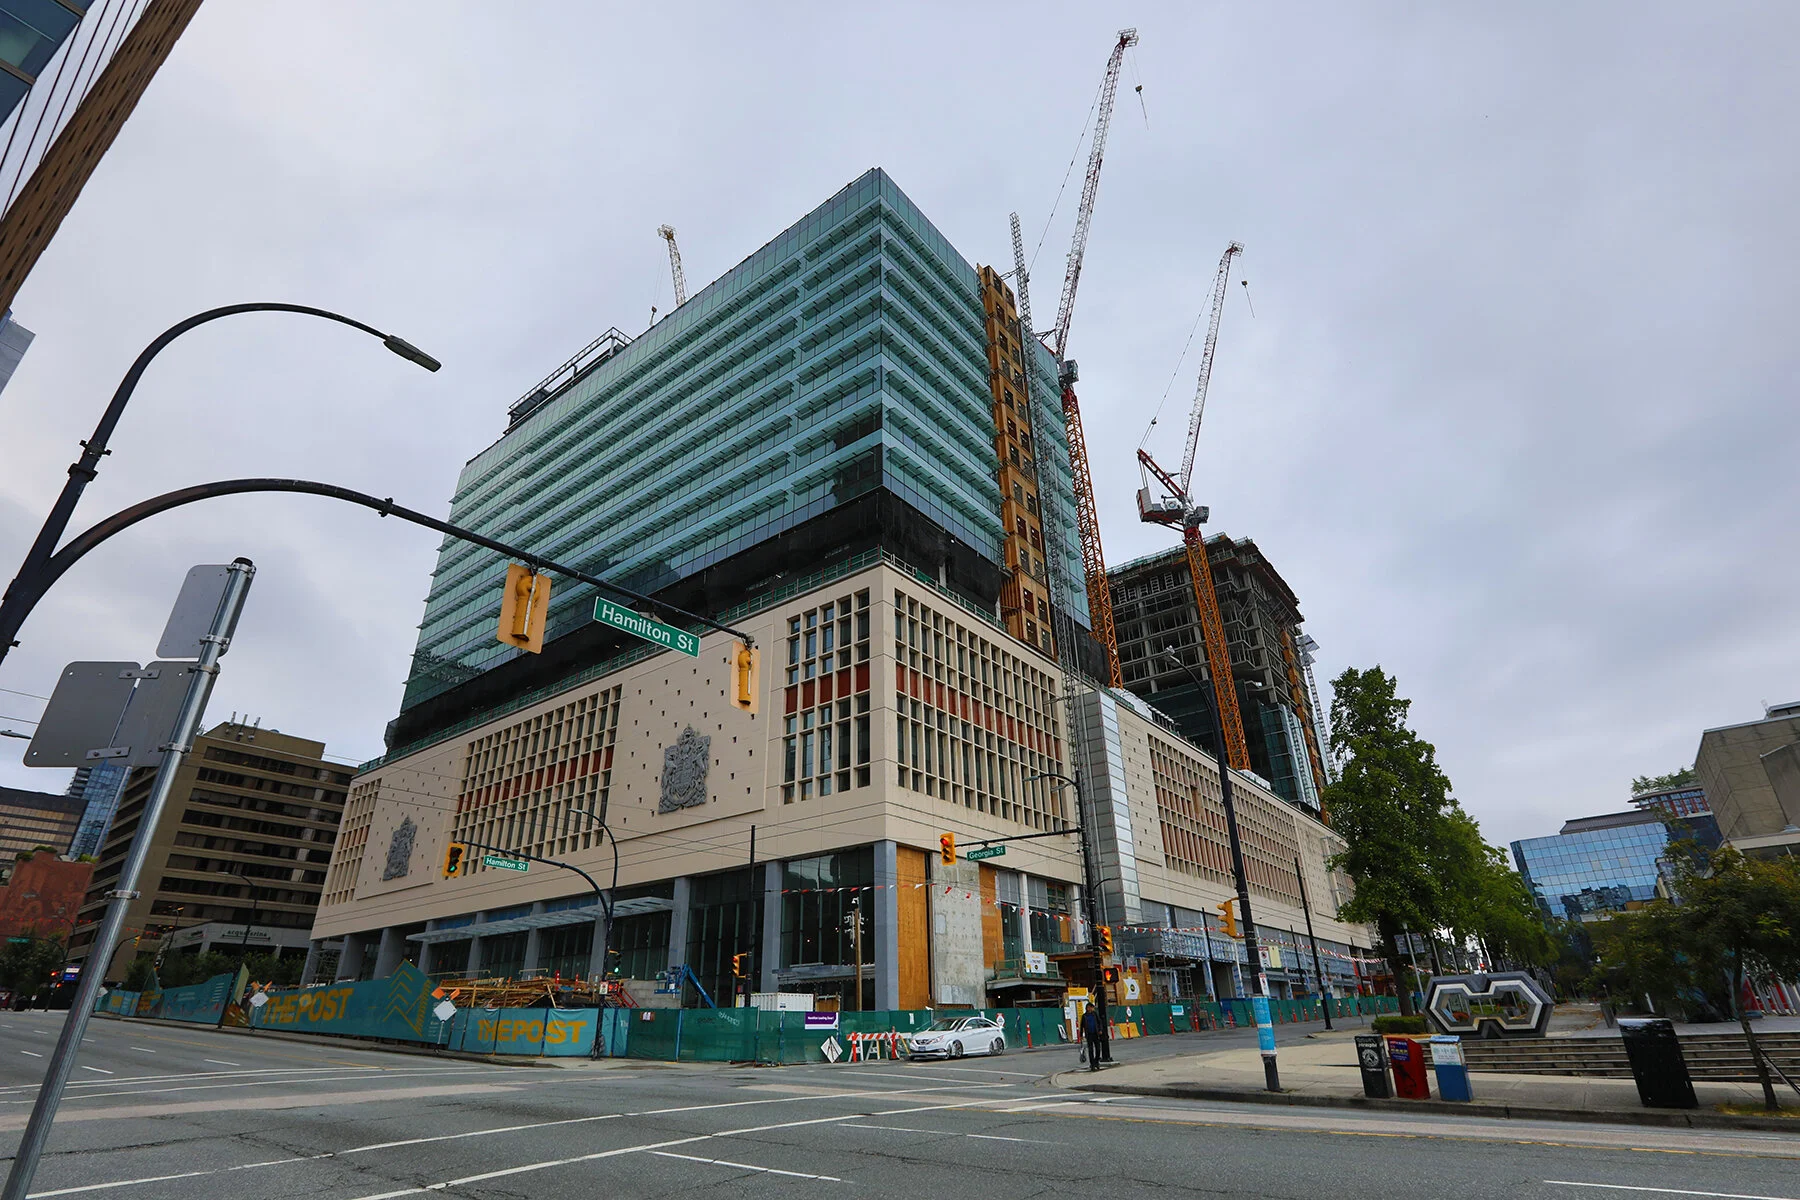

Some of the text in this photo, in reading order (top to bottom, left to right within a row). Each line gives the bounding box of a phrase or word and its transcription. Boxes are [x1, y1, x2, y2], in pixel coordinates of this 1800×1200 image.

[602, 604, 694, 652] Hamilton St
[969, 850, 994, 859] Georgia
[486, 857, 526, 870] Hamilton St
